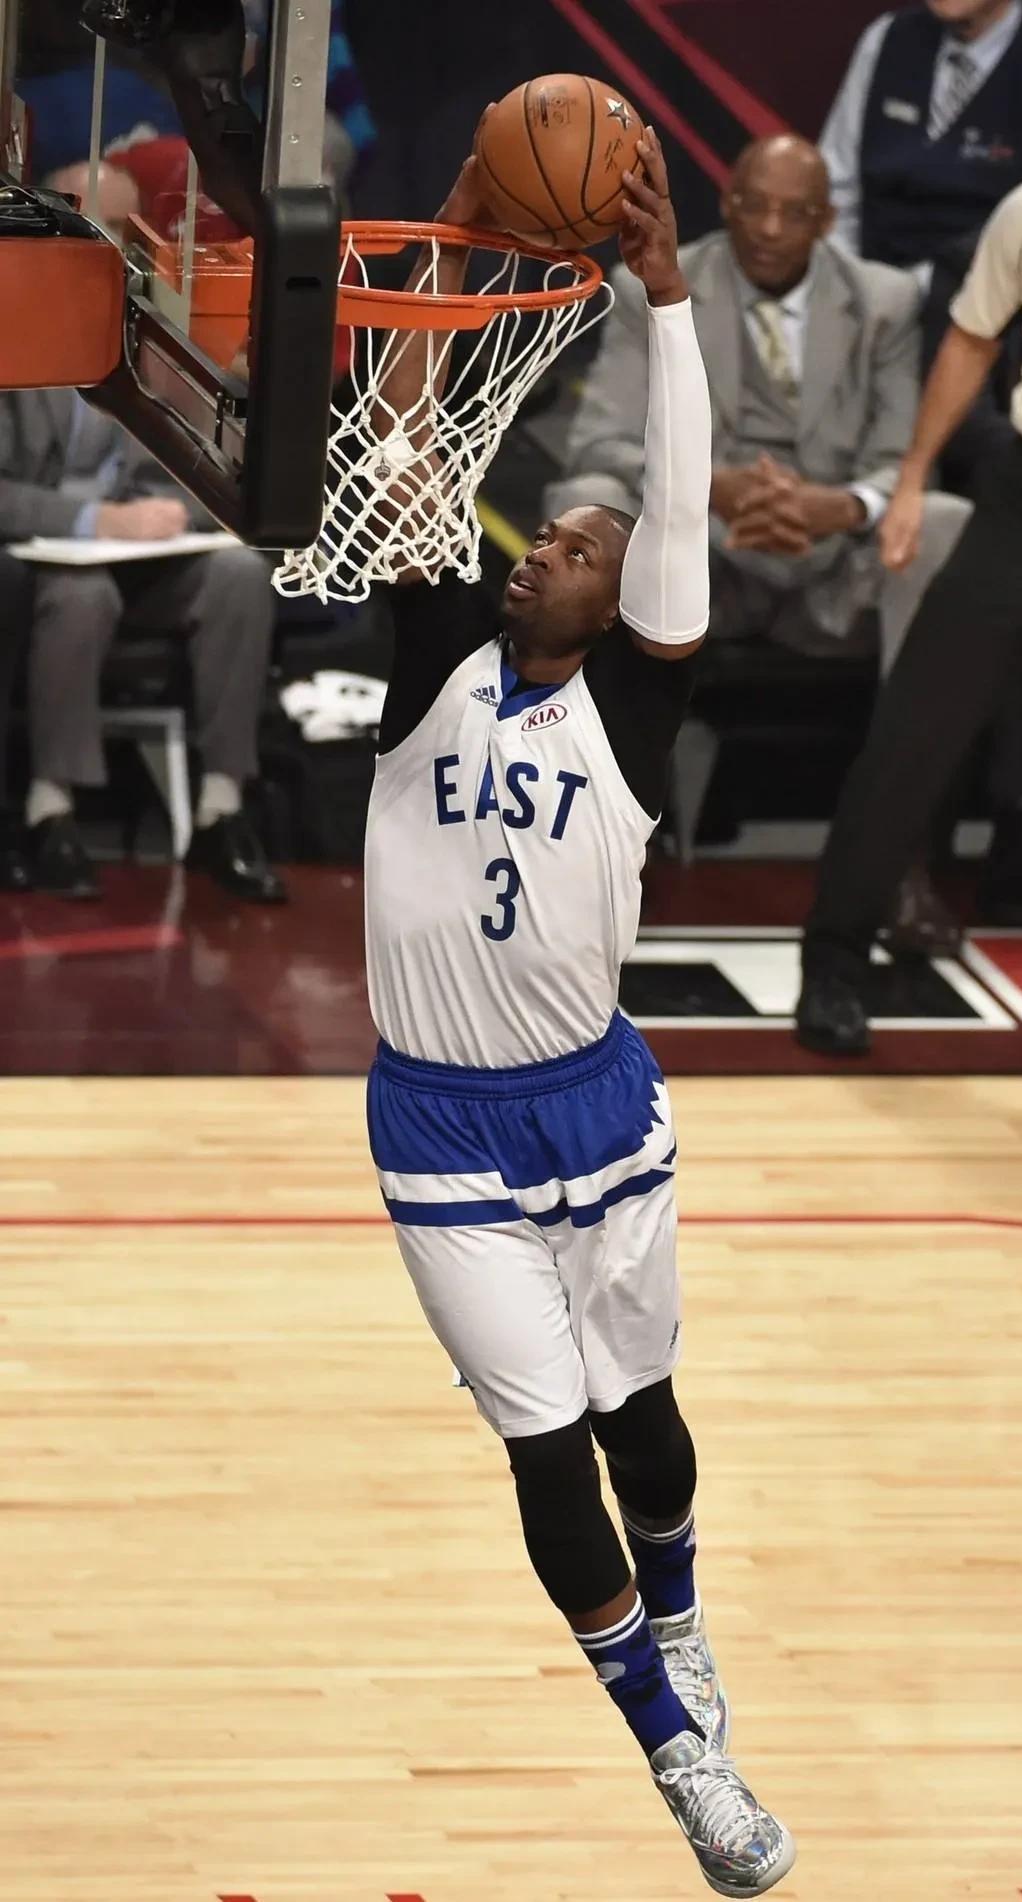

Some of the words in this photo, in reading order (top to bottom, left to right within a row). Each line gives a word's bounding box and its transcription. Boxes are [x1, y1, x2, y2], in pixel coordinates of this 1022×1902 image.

[527, 707, 559, 728] KIA
[433, 753, 588, 841] EAST
[480, 857, 522, 941] 3
